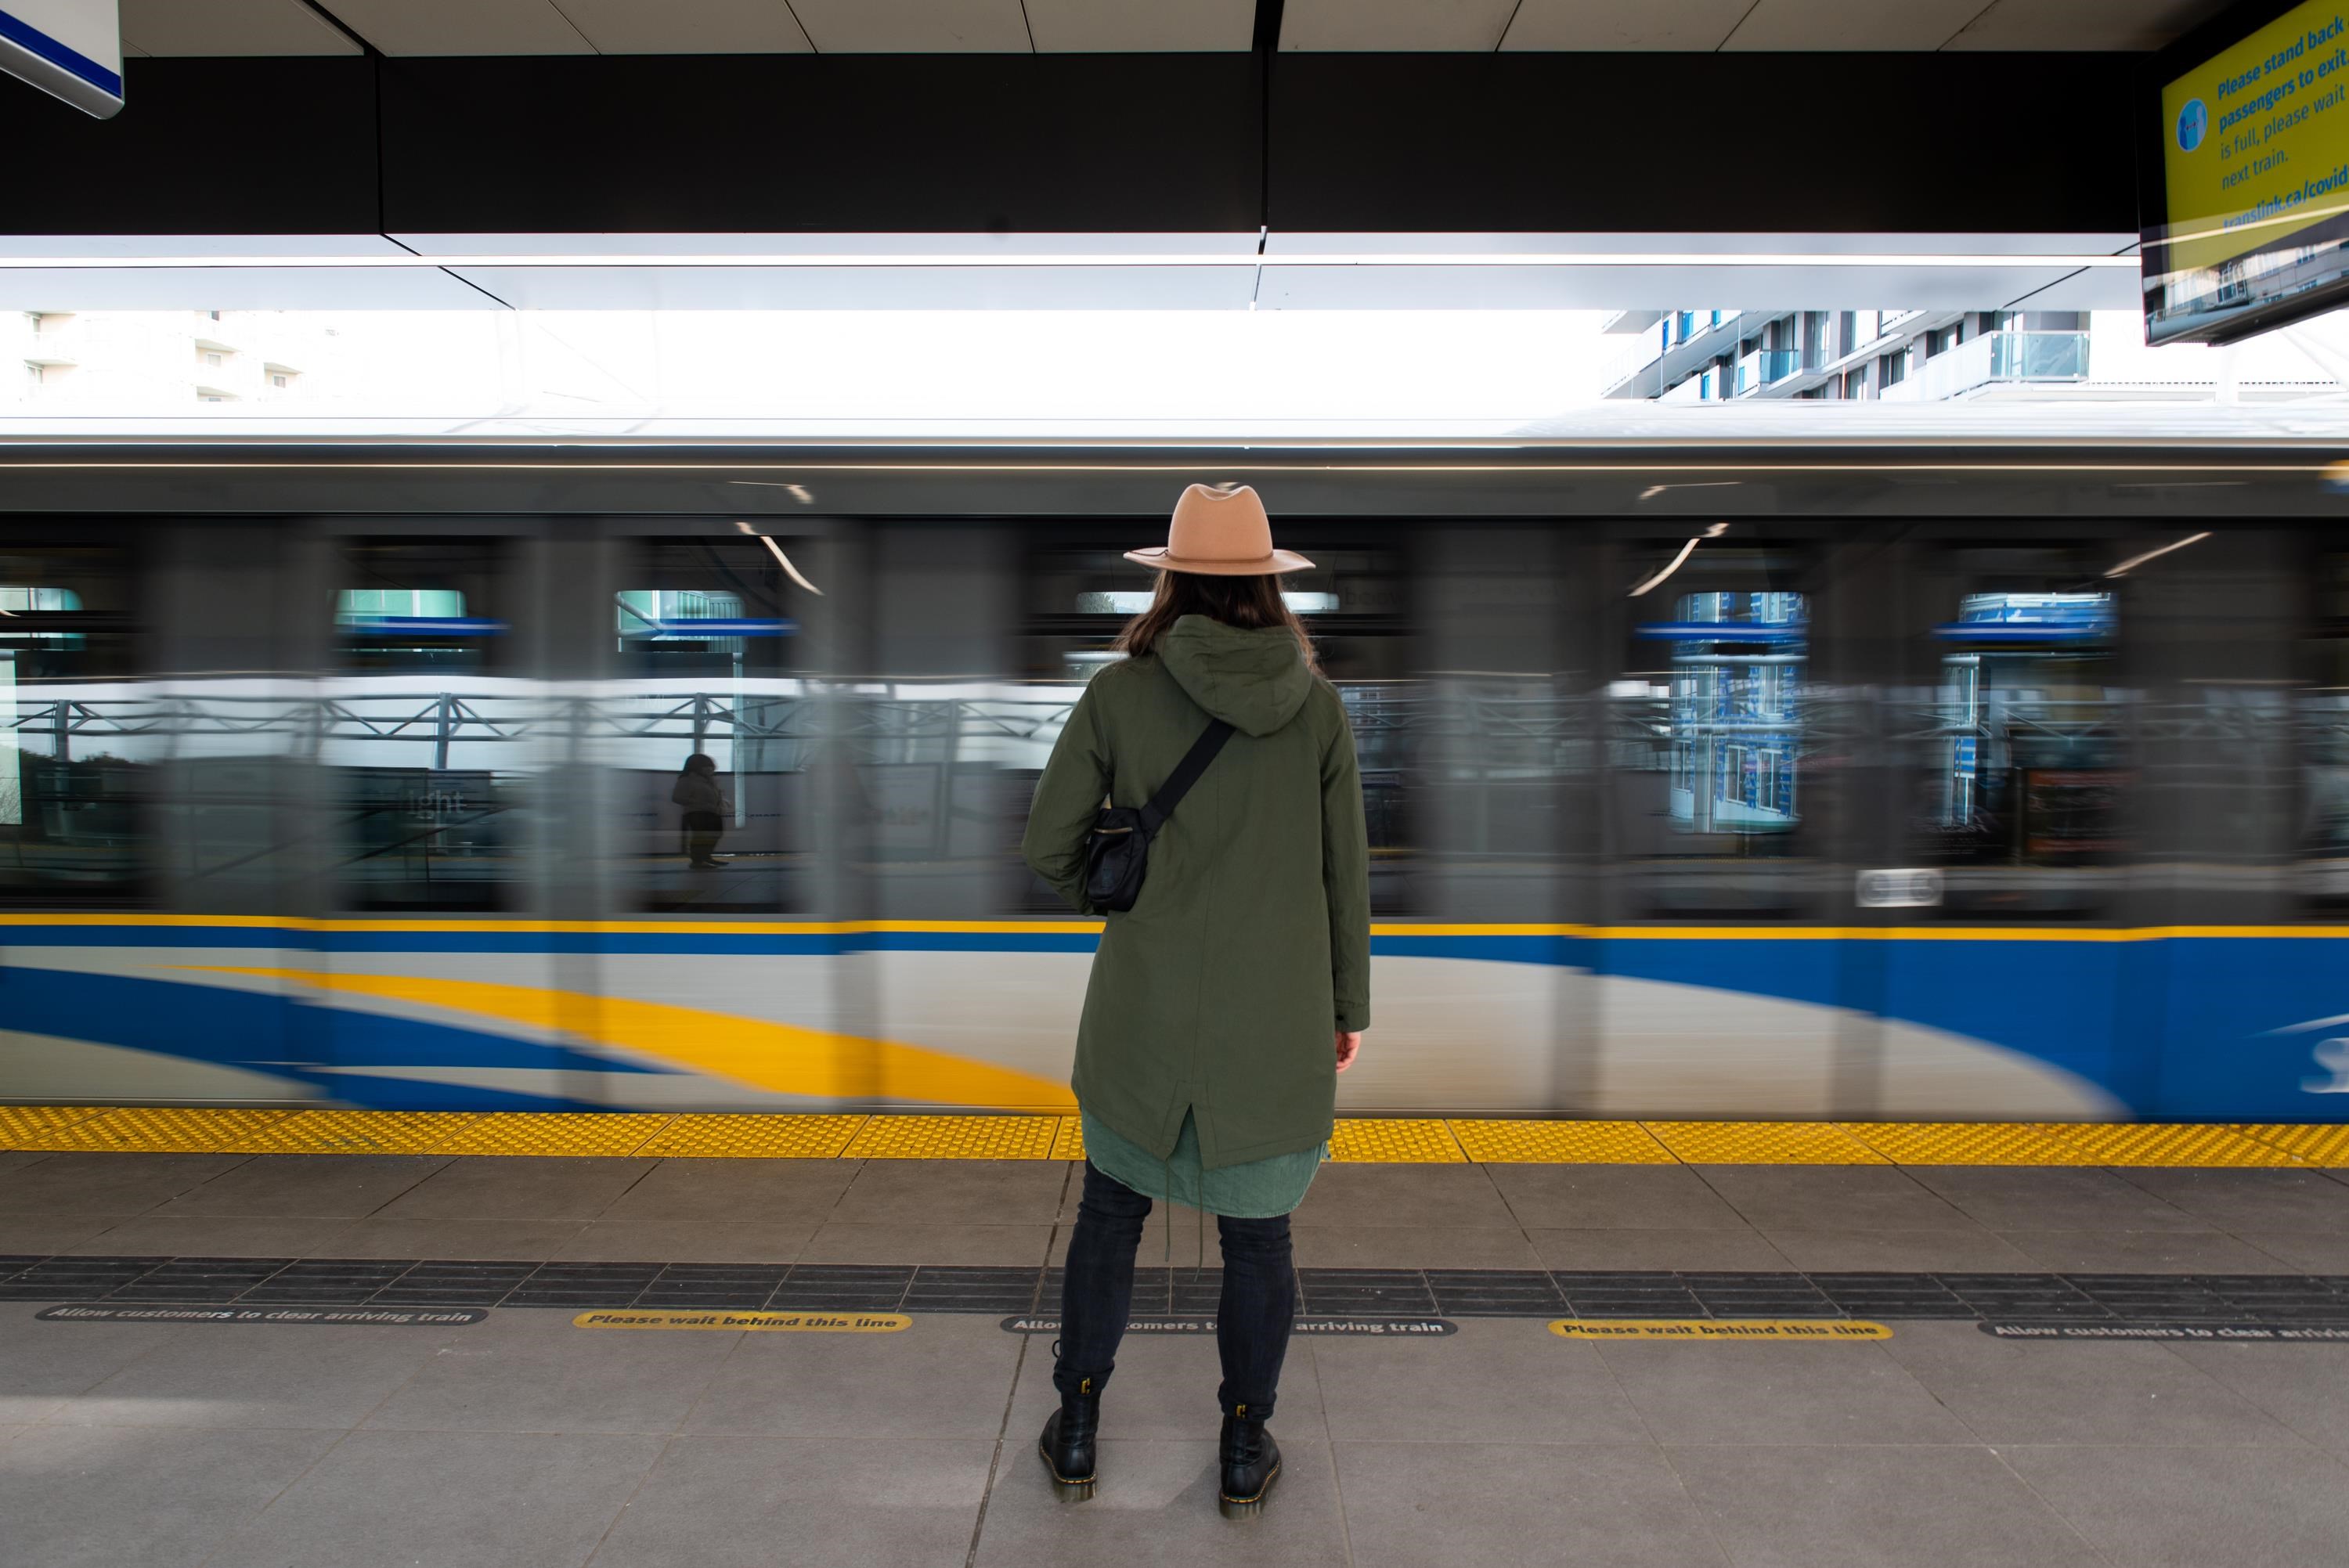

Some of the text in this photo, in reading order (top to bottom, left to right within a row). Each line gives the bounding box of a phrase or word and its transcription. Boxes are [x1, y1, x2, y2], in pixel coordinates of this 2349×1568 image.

[2217, 15, 2344, 100] Please stand back
[2219, 78, 2296, 135] passengers
[2298, 70, 2315, 88] to
[2220, 83, 2346, 161] is full, please wait
[2221, 148, 2289, 190] next train.
[2223, 163, 2349, 234] translink.ca/covid
[47, 1307, 473, 1322] Allow customers to clear arriving train
[586, 1314, 898, 1328] Please wait behind this line
[1295, 1321, 1445, 1333] arriving train
[1562, 1325, 1879, 1335] Please wait behind this line
